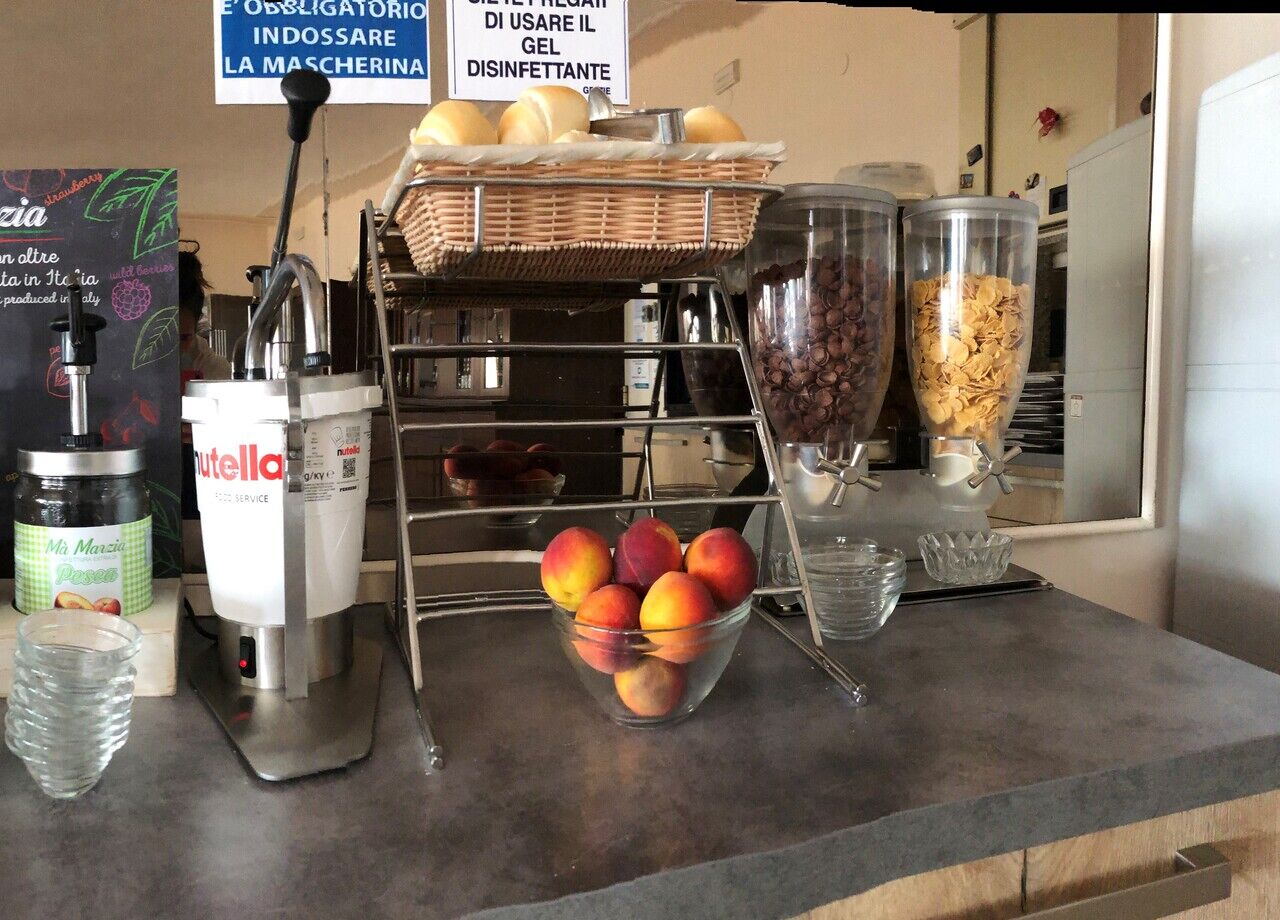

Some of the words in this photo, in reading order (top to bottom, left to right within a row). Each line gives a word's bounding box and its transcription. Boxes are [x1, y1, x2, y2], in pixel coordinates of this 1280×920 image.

[244, 0, 428, 20] OBBLIGATORIO
[485, 12, 503, 30] DI
[510, 13, 574, 32] USARE
[579, 14, 596, 33] IL
[253, 26, 397, 47] INDOSSARE
[521, 37, 561, 55] GEL
[224, 56, 254, 74] LA
[263, 56, 425, 75] MASCHERINA
[467, 59, 611, 81] DISINFETTANTE
[44, 172, 103, 207] strawberry
[18, 247, 60, 265] oltre
[24, 273, 41, 287] in
[46, 268, 100, 287] Itaia
[109, 267, 134, 279] wild
[136, 262, 176, 277] berries
[4, 292, 57, 307] produced
[81, 292, 101, 307] aly
[235, 494, 269, 503] SERVICE
[46, 539, 68, 555] Mà
[73, 538, 126, 555] Marzia
[55, 563, 119, 586] Pesca
